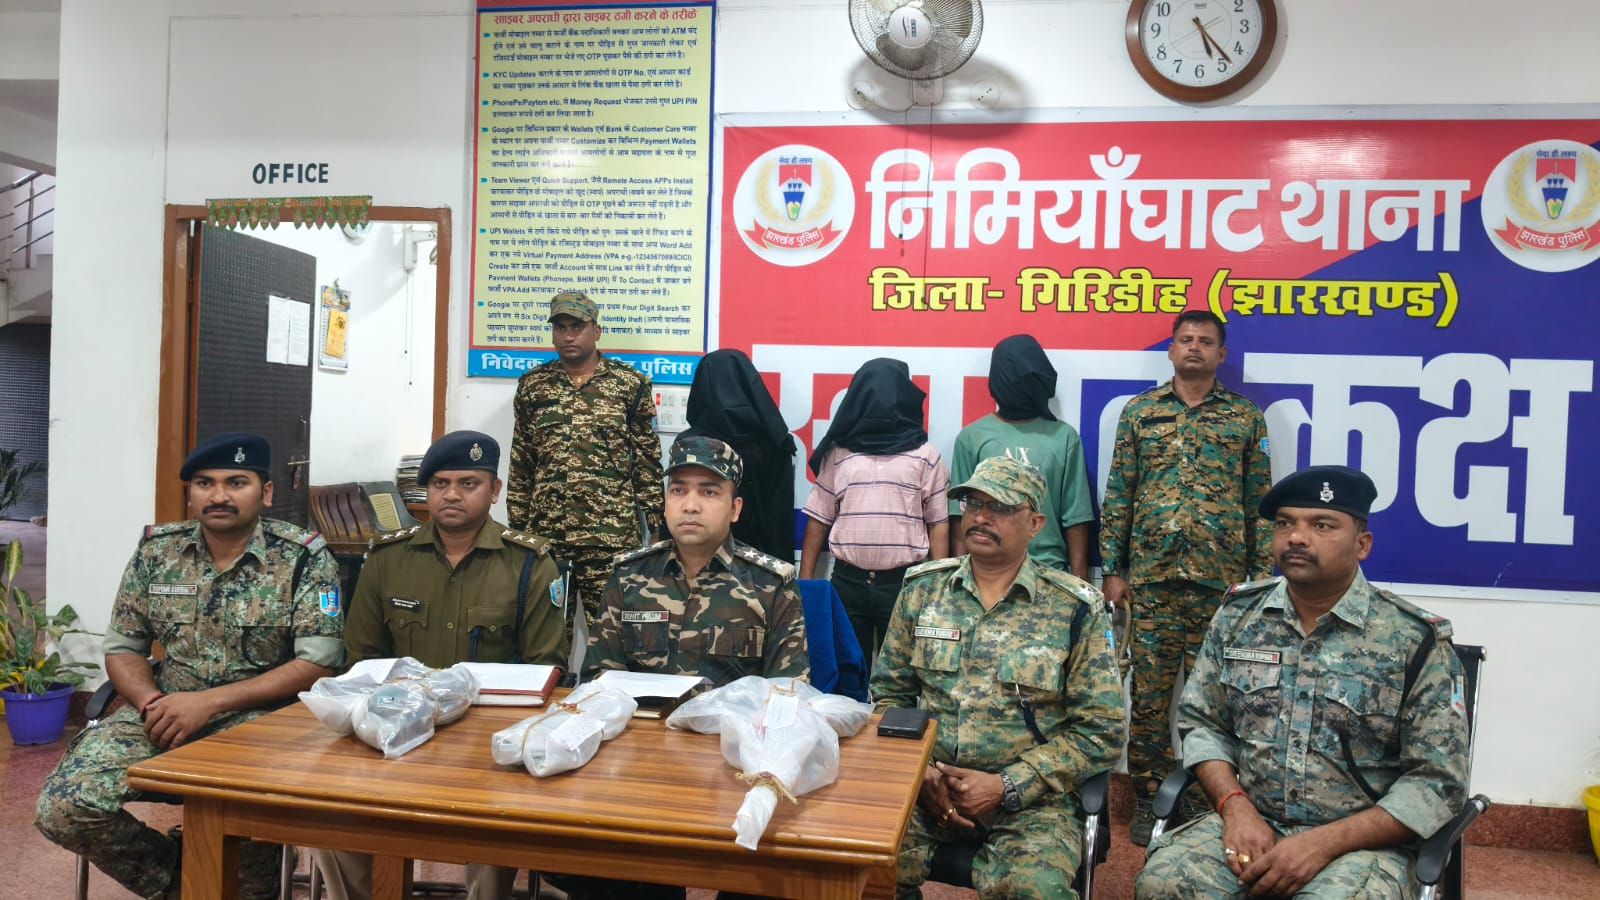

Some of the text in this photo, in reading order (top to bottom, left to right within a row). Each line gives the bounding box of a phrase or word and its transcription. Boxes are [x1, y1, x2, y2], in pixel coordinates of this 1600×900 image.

[1157, 2, 1171, 17] 10
[1234, 0, 1244, 12] 2
[659, 9, 669, 20] के
[672, 8, 698, 20] तरीके
[1151, 23, 1161, 38] 9
[1240, 19, 1249, 33] 3
[1157, 44, 1167, 60] 8
[1234, 41, 1243, 55] 4
[1173, 59, 1183, 73] 7
[1195, 64, 1205, 78] 6
[1217, 58, 1227, 72] 5
[252, 163, 329, 184] OFFICE
[865, 145, 1470, 252] निमियाँघाट थाना
[797, 230, 820, 247] पुलिस
[1558, 230, 1585, 248] पुलिस
[867, 266, 1004, 312] जिला-
[1015, 267, 1191, 314] गिरिडीह
[641, 358, 693, 377] पुलिस
